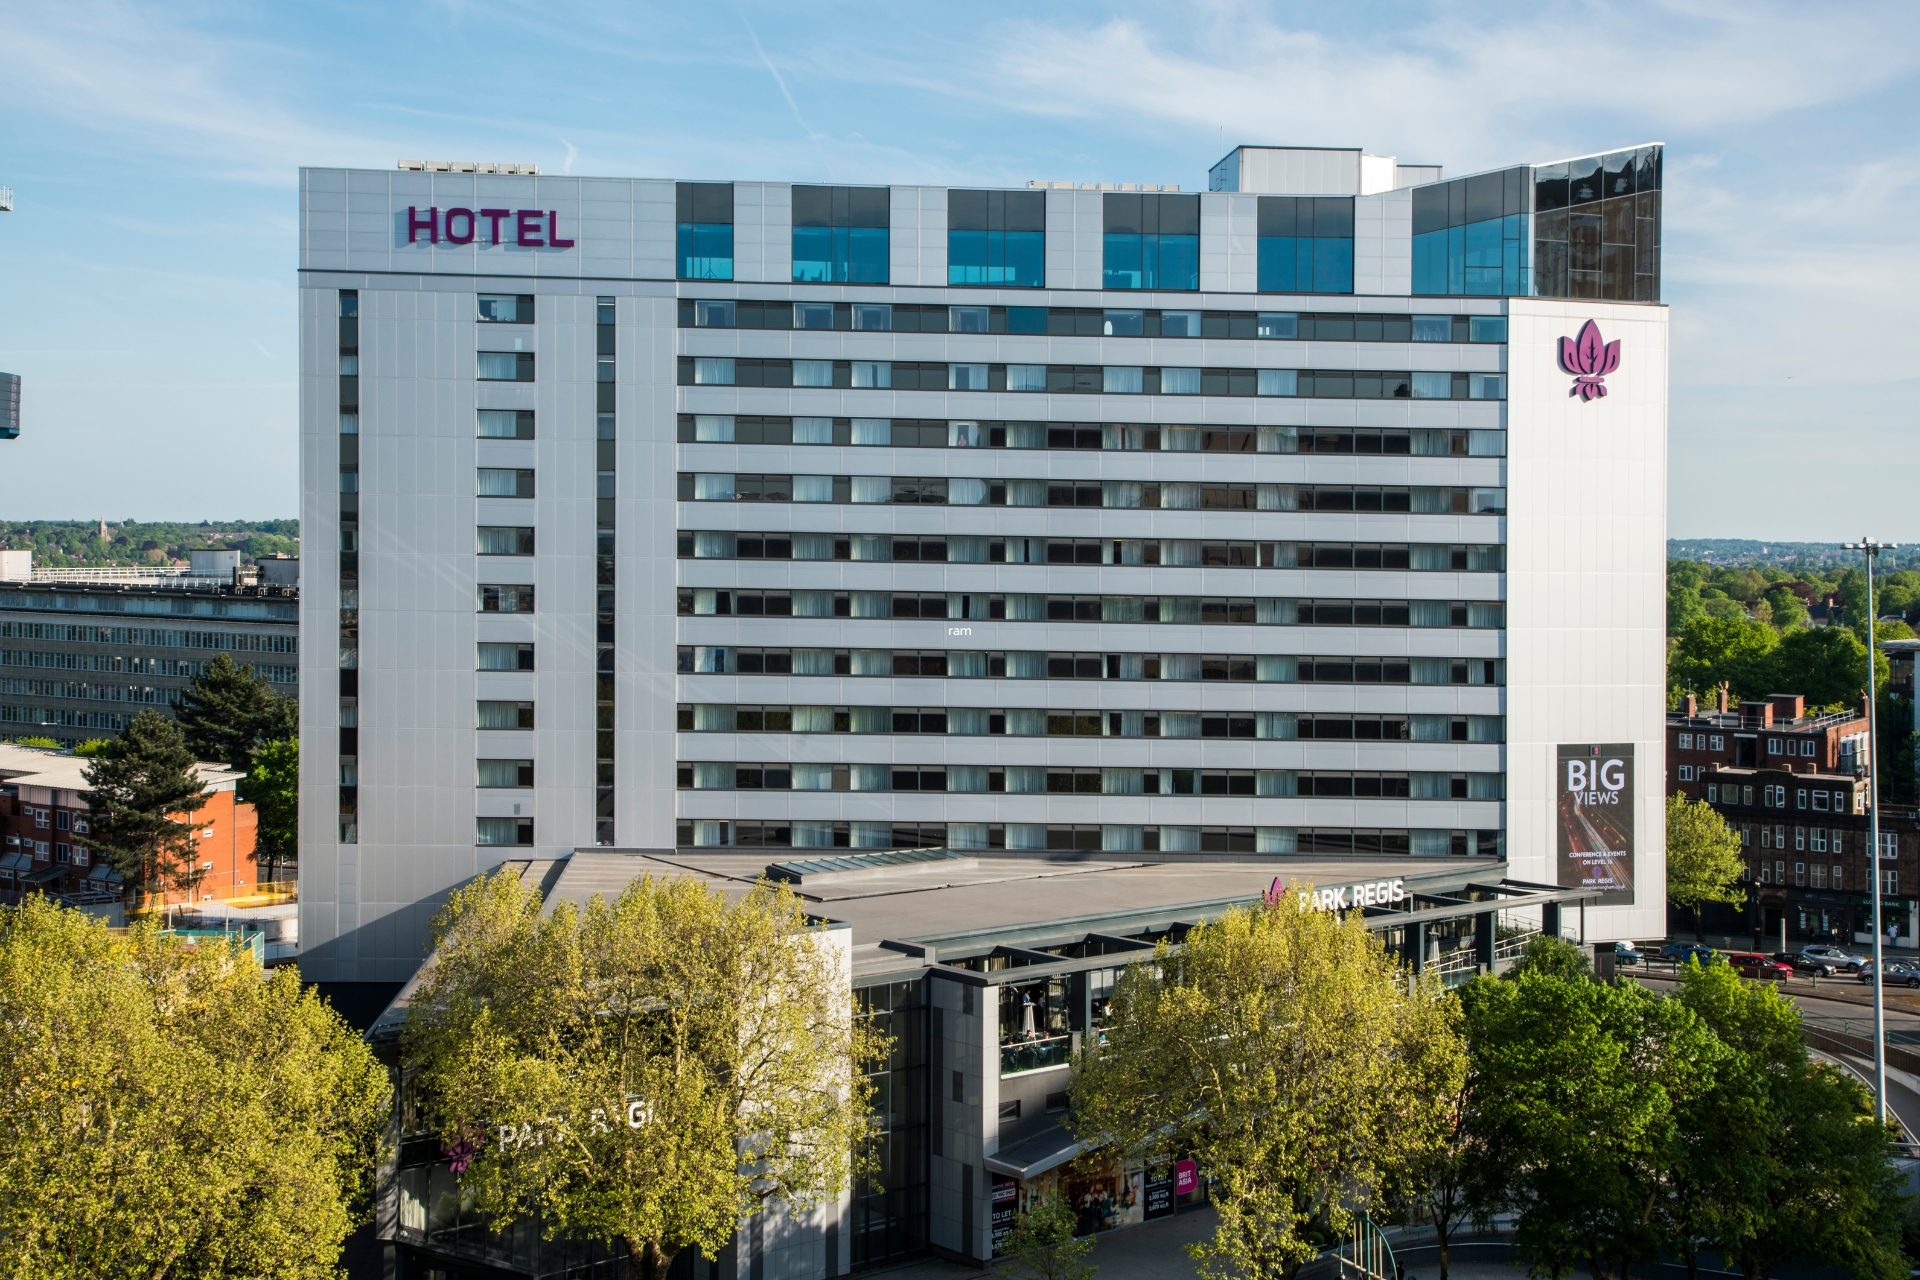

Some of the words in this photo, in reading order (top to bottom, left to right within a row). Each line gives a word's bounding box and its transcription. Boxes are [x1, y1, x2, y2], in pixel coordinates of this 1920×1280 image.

[408, 206, 575, 248] HOTEL
[1568, 759, 1625, 791] BIG
[1573, 791, 1619, 805] VIEWS
[1298, 886, 1347, 911] PARK
[1352, 880, 1404, 907] REGIS
[1178, 1170, 1192, 1179] BRIT
[1178, 1177, 1192, 1186] ASIA
[992, 1212, 1001, 1220] TO
[1001, 1209, 1012, 1218] LET
